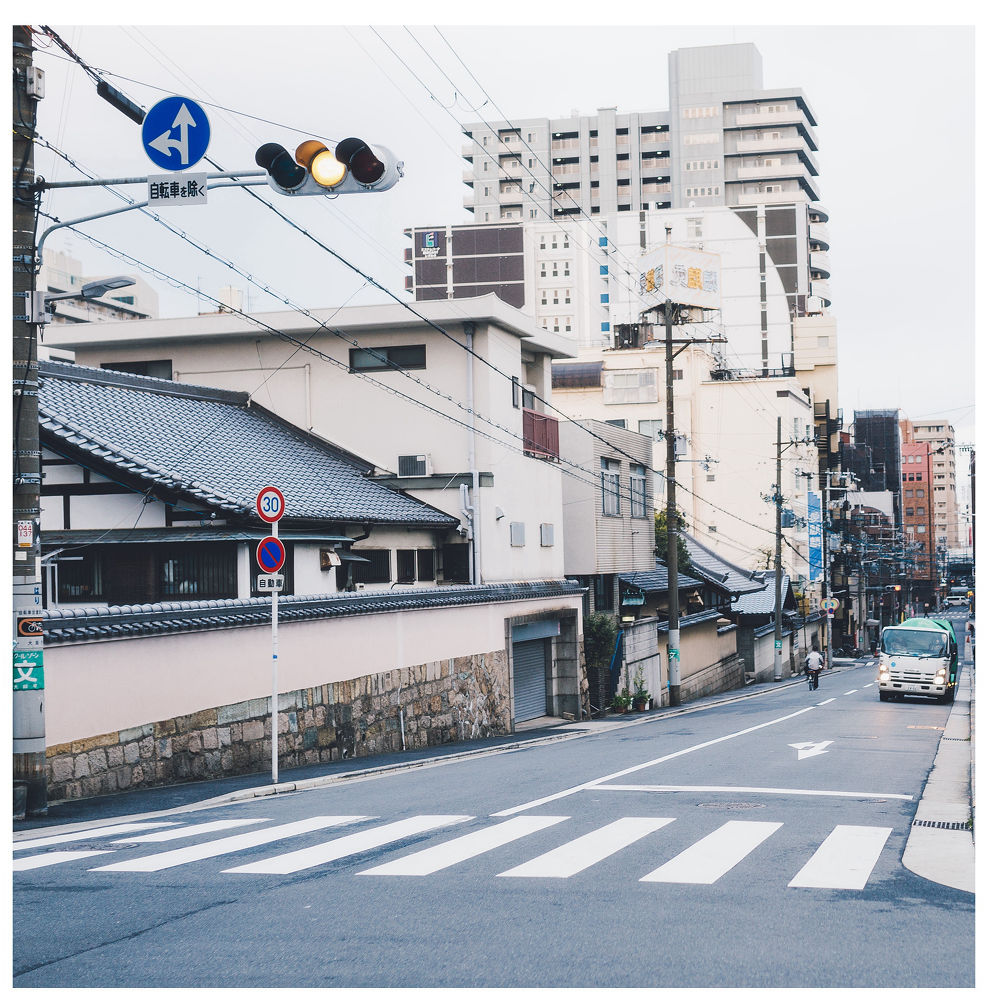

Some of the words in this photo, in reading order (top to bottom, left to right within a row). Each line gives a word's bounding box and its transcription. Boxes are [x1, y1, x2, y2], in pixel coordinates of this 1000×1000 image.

[150, 180, 205, 199] 自転車を除く
[263, 497, 279, 512] 30
[260, 579, 283, 588] 自動車
[14, 660, 38, 683] 文
